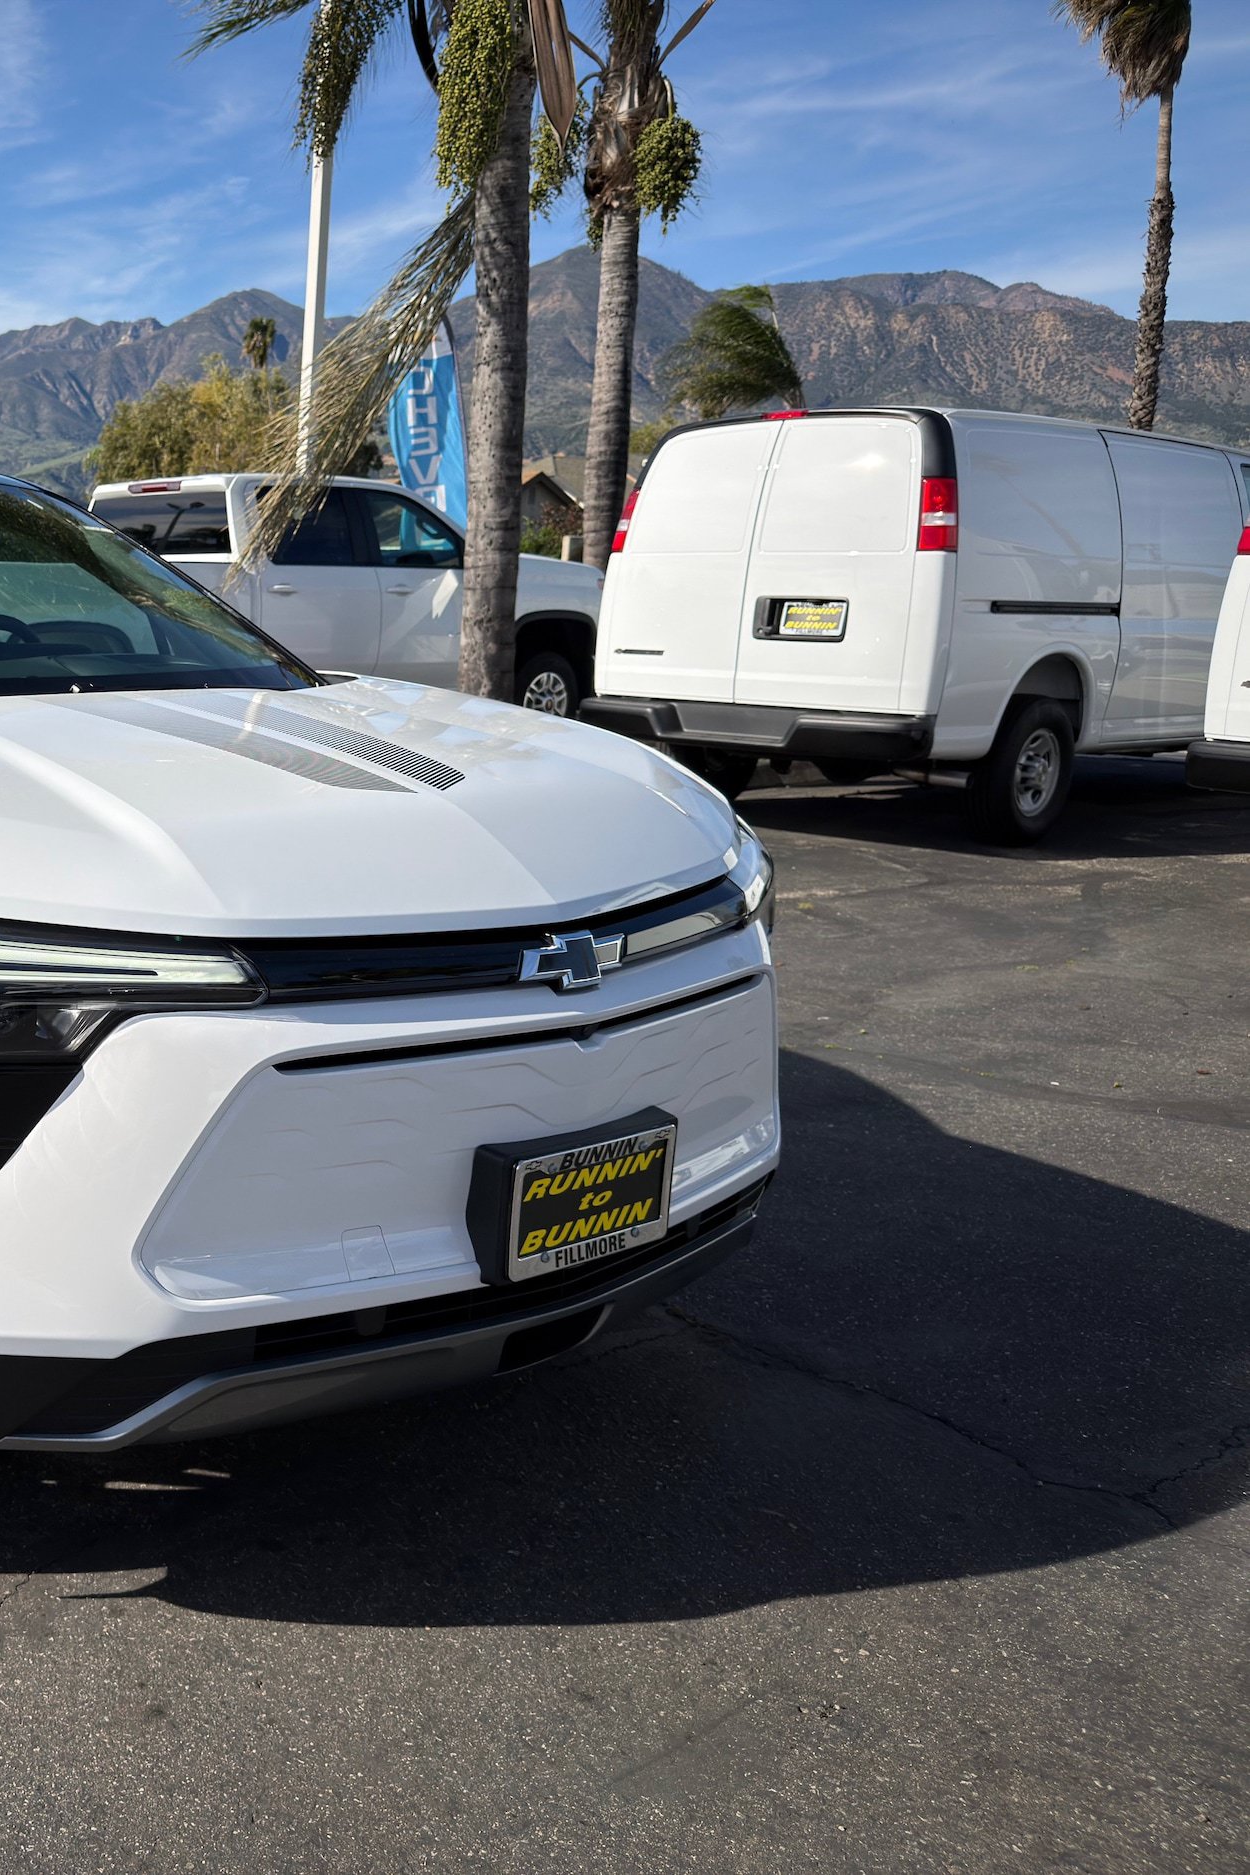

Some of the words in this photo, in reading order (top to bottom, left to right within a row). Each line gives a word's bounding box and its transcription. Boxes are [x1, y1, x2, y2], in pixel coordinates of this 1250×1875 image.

[559, 1137, 639, 1171] BUNNIN
[523, 1148, 664, 1202] RUNNIN'
[578, 1190, 613, 1211] to
[519, 1198, 653, 1256] BUNNIN
[555, 1232, 626, 1268] FILLMORE
